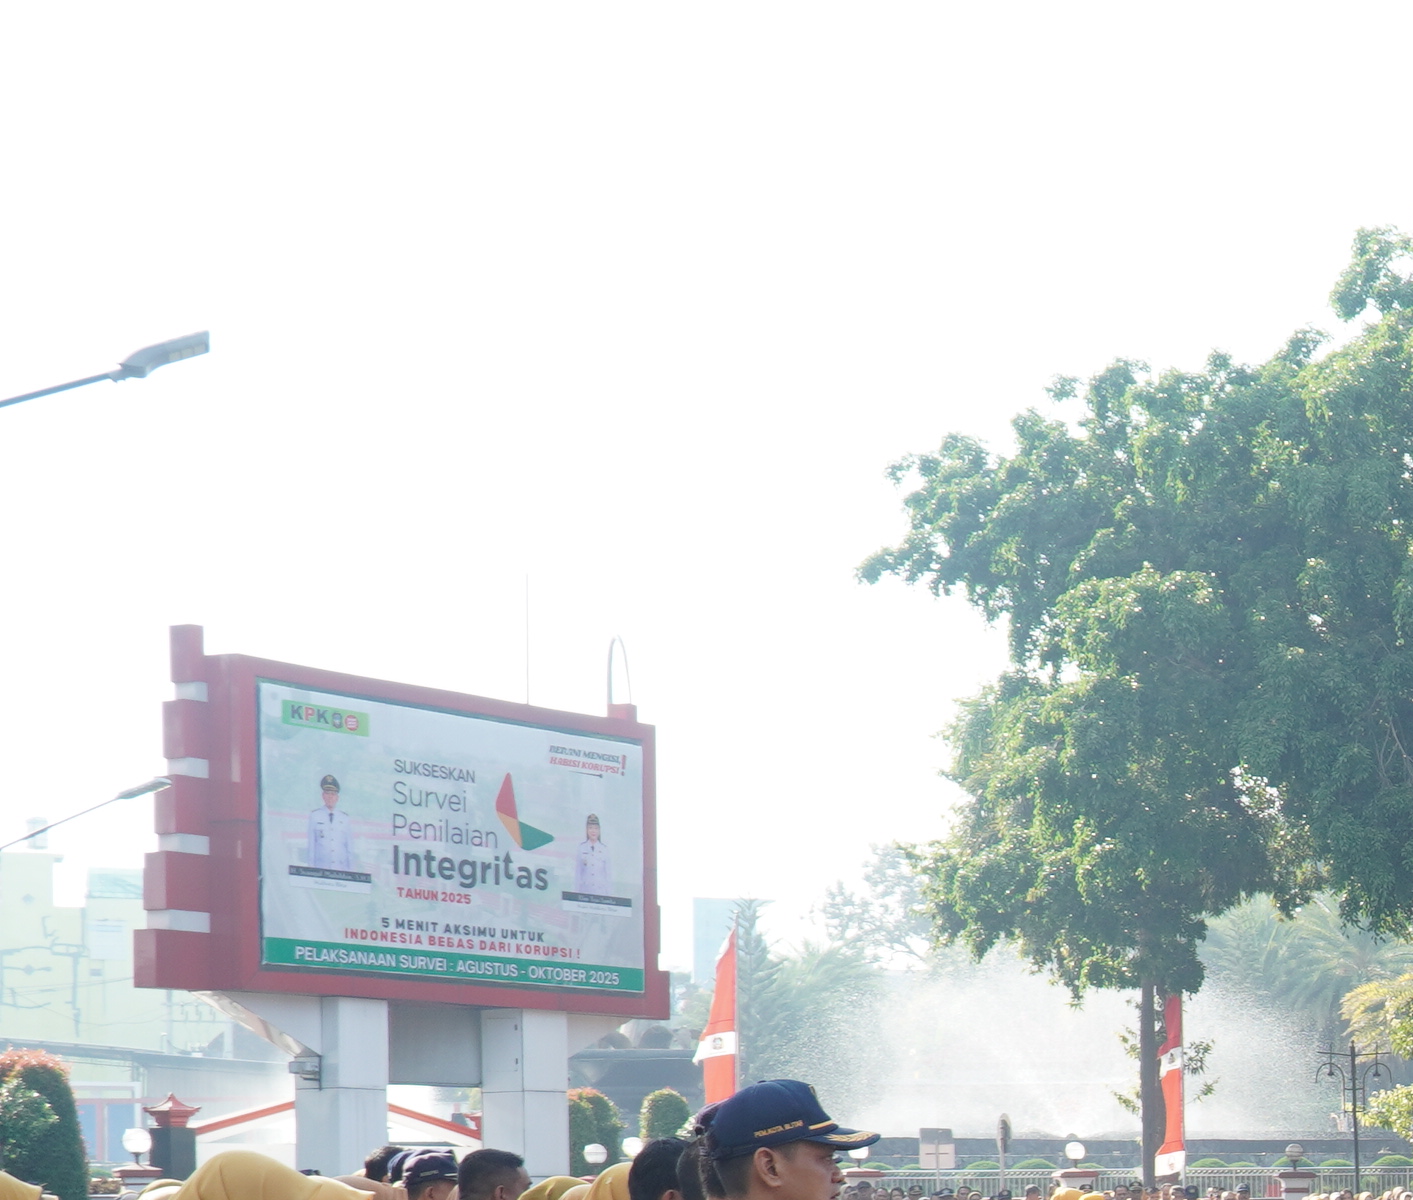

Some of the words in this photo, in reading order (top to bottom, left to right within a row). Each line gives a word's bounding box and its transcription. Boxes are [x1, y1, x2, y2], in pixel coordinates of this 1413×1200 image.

[290, 704, 330, 725] KPK
[393, 759, 476, 784] SUKSESKAN
[581, 761, 620, 775] KORUPSI
[393, 781, 467, 813] Survei
[393, 813, 498, 849] Penilaian
[393, 845, 549, 891] Integritas
[397, 887, 438, 901] TAHUN
[441, 892, 472, 904] 2025
[344, 927, 424, 945] INDONESIA
[479, 940, 511, 953] DARI
[515, 943, 573, 958] KORUPSI
[381, 917, 390, 928] 5
[395, 918, 439, 932] MENIT
[443, 923, 496, 938] AKSIMU
[501, 929, 544, 943] UNTUK
[294, 945, 397, 968] PELAKSANAAN
[400, 954, 448, 971] SURVEI
[456, 960, 519, 977] AGUSTUS
[528, 965, 587, 982] OKTOBER
[589, 970, 620, 985] 2025
